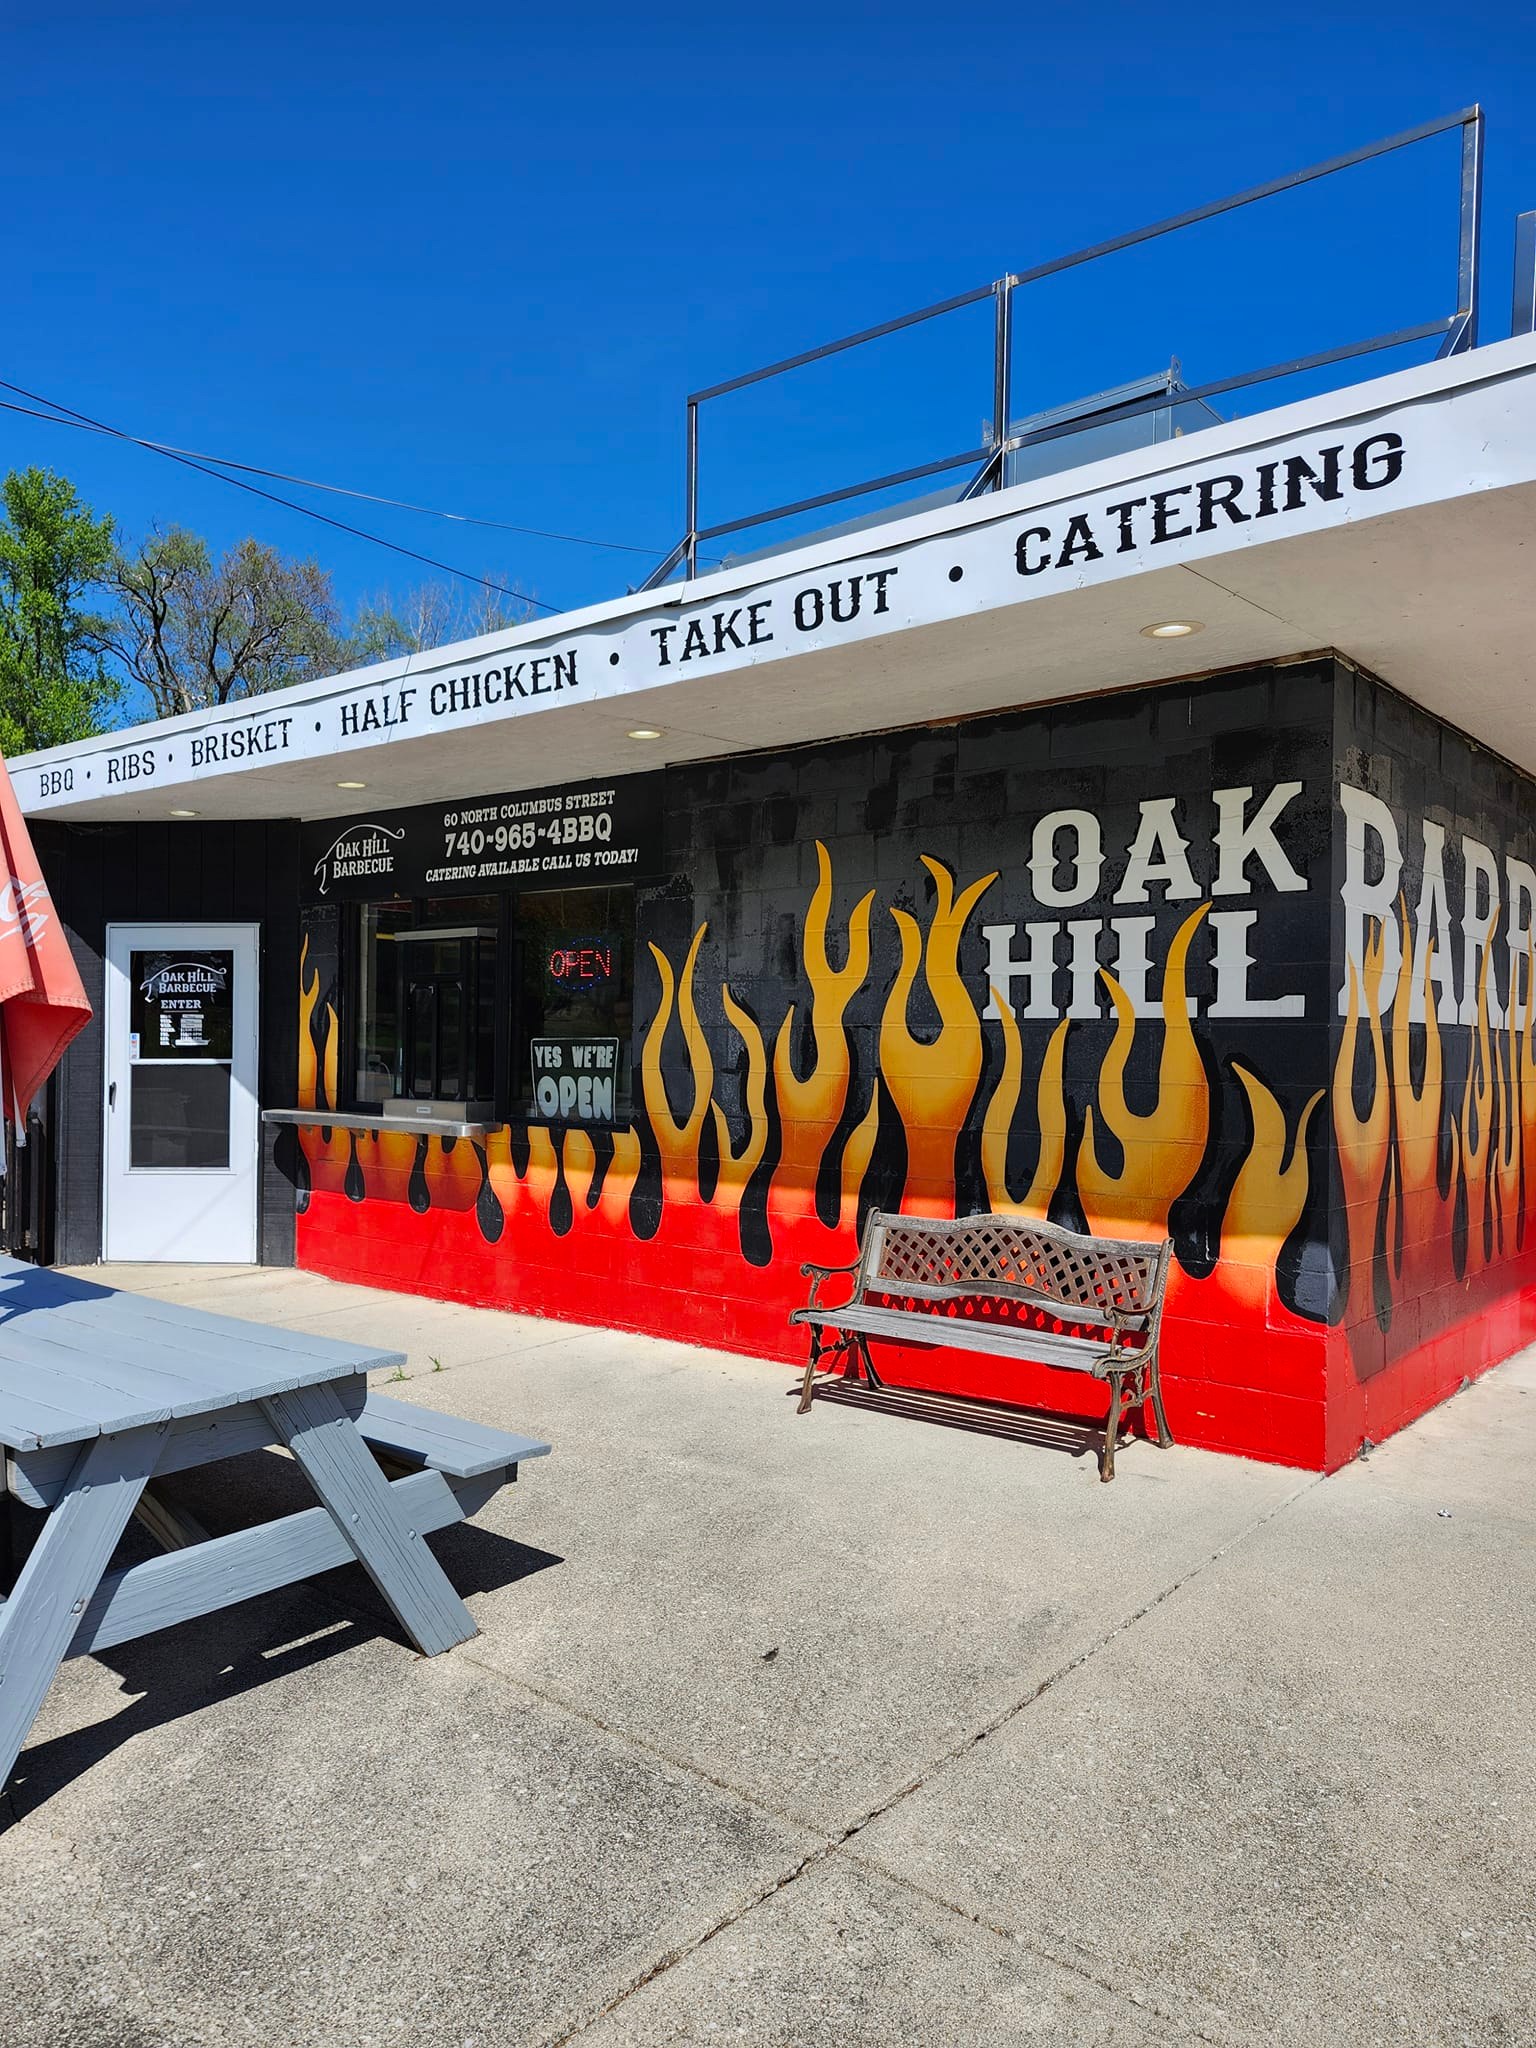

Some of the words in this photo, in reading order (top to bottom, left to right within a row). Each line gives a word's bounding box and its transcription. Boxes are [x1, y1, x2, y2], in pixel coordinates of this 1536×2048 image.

[40, 768, 74, 797] BBQ
[107, 751, 155, 784] RIBS
[191, 718, 293, 767] BRISKET
[341, 689, 417, 737] HALF
[430, 650, 579, 716] CHICKEN
[651, 600, 774, 666] TAKE
[793, 567, 899, 632] OUT
[1014, 432, 1407, 577] CATERING
[444, 813, 458, 827] 60
[461, 807, 498, 825] NORTH
[501, 797, 562, 819] COLUMBUS
[565, 790, 616, 810] STREET
[336, 842, 361, 860] OAK
[362, 832, 390, 857] HILL
[1026, 781, 1309, 908] OAK
[333, 857, 394, 879] BARBECUE
[425, 864, 477, 882] CATERING
[478, 858, 540, 877] AVAILABLE
[542, 855, 573, 870] CALL
[575, 853, 591, 867] US
[594, 848, 639, 866] TODAY!
[161, 972, 186, 983] OAK
[187, 968, 214, 983] HILL
[550, 949, 611, 977] OPEN
[982, 910, 1306, 1020] HILL
[159, 983, 217, 993] BARBECUE
[161, 1000, 202, 1009] ENTER
[534, 1046, 562, 1068] YES
[573, 1046, 613, 1068] WE'RE
[537, 1076, 612, 1121] OPEN
